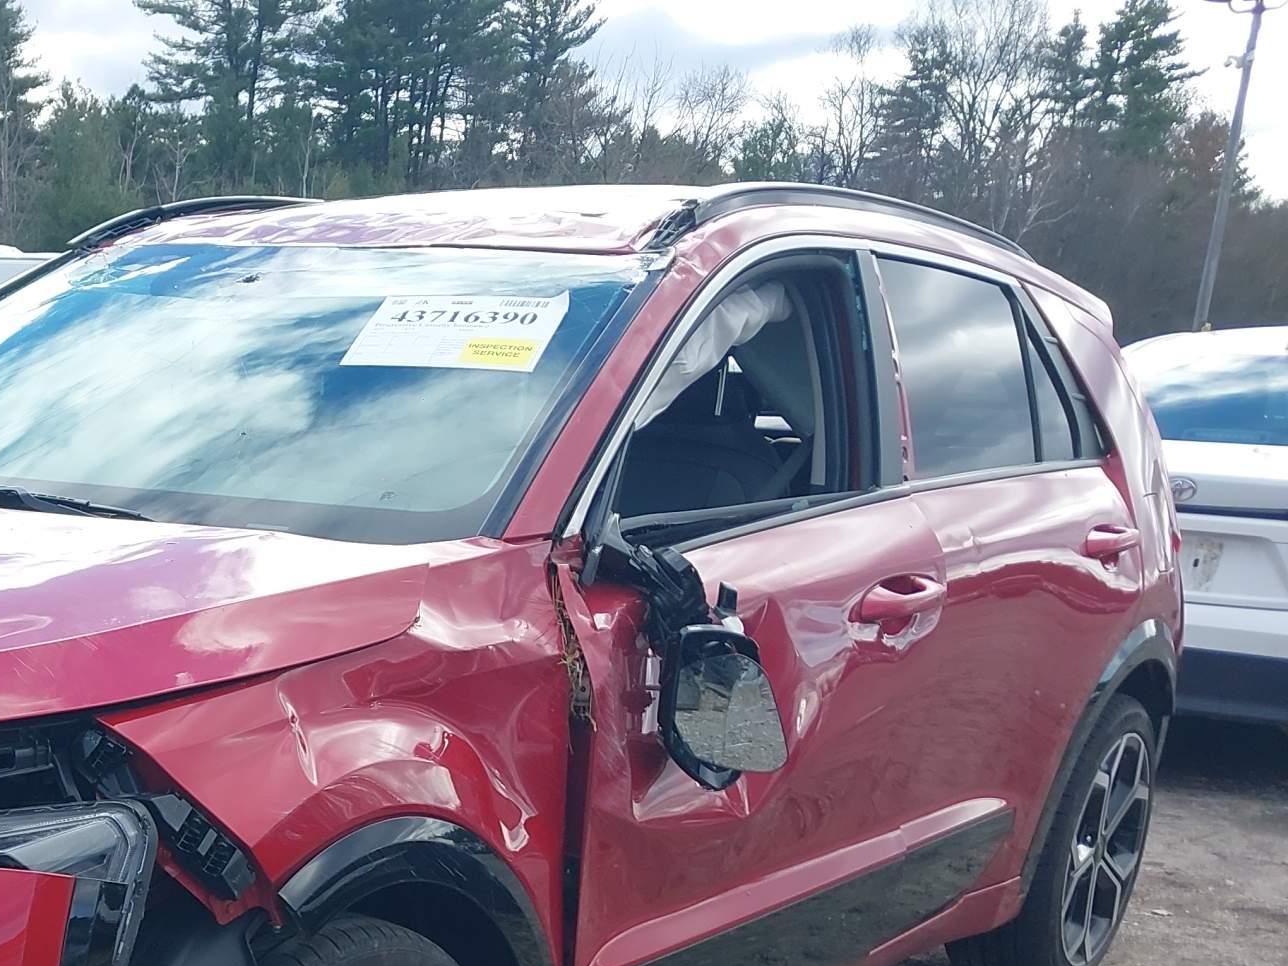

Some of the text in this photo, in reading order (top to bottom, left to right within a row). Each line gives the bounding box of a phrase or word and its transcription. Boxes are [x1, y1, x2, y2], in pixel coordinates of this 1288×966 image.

[391, 310, 538, 325] 43716390
[468, 343, 533, 351] INSPECTION
[472, 349, 521, 358] SERVICE
